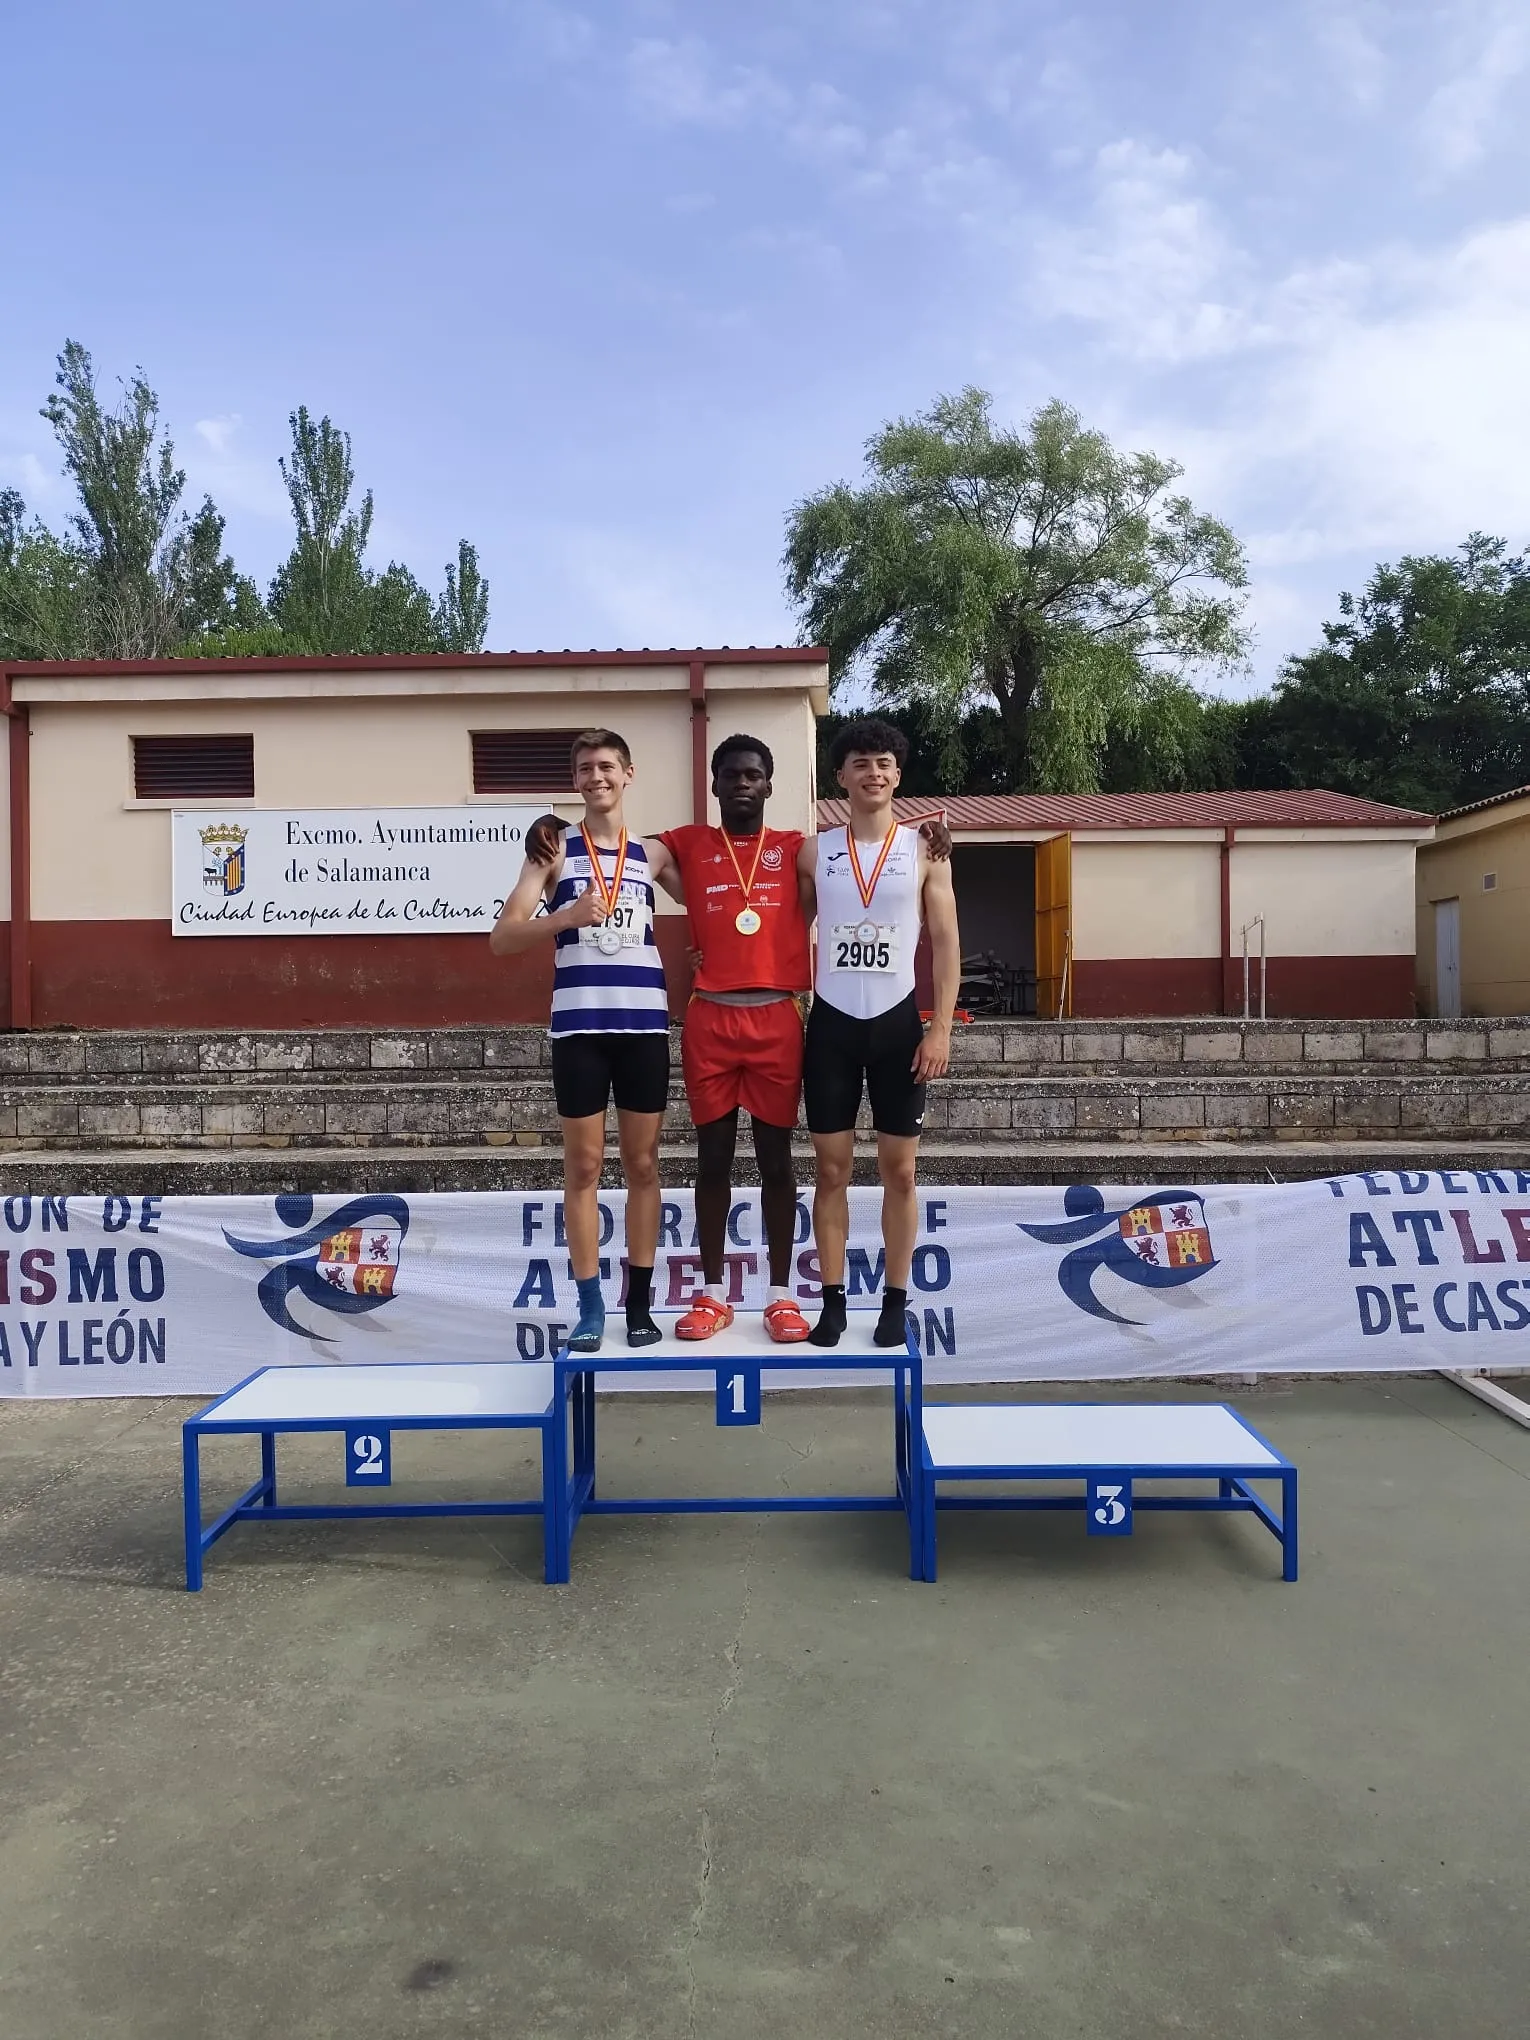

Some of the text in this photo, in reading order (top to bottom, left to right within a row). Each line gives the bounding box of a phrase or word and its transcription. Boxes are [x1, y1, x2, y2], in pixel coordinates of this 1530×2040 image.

[285, 819, 521, 851] Excmo. Ayuntamiento
[284, 857, 430, 883] de Salamanca
[179, 901, 256, 924] Ciudad
[263, 901, 343, 928] Europea
[346, 900, 371, 920] de
[374, 899, 399, 919] la
[403, 899, 486, 920] Cultura
[837, 942, 889, 968] 2905
[103, 1196, 163, 1233] DE
[1355, 1284, 1425, 1335] DE
[58, 1309, 166, 1366] LEÓN
[727, 1375, 746, 1413] 1
[353, 1435, 382, 1474] 2
[1094, 1485, 1125, 1524] 3
